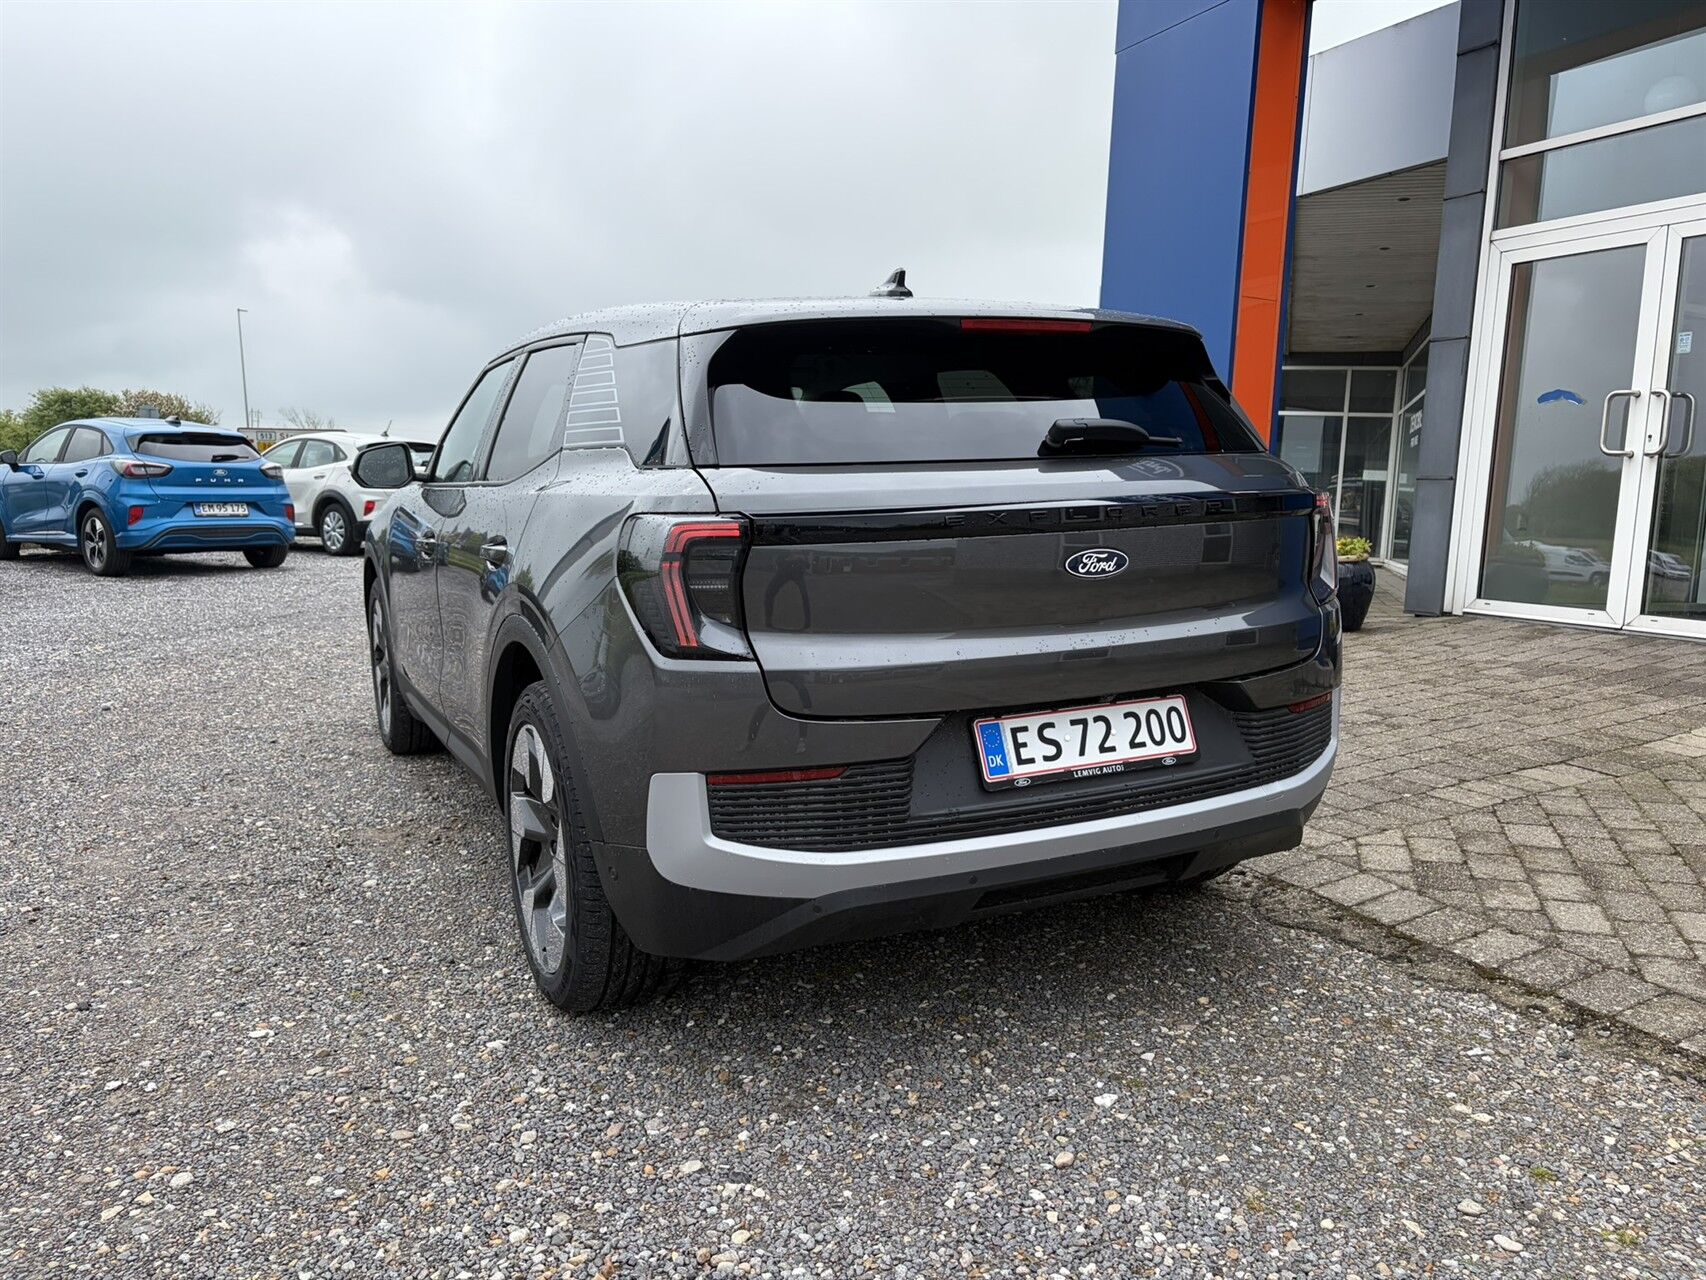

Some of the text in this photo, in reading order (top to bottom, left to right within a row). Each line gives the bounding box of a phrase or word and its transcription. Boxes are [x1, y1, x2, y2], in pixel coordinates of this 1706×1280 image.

[202, 502, 215, 513] EM
[216, 502, 228, 513] 95
[229, 502, 247, 513] 175
[1078, 552, 1118, 574] Ford
[1010, 705, 1187, 766] ES 72 200
[988, 754, 1005, 768] DK
[1073, 767, 1101, 778] LEMVIG
